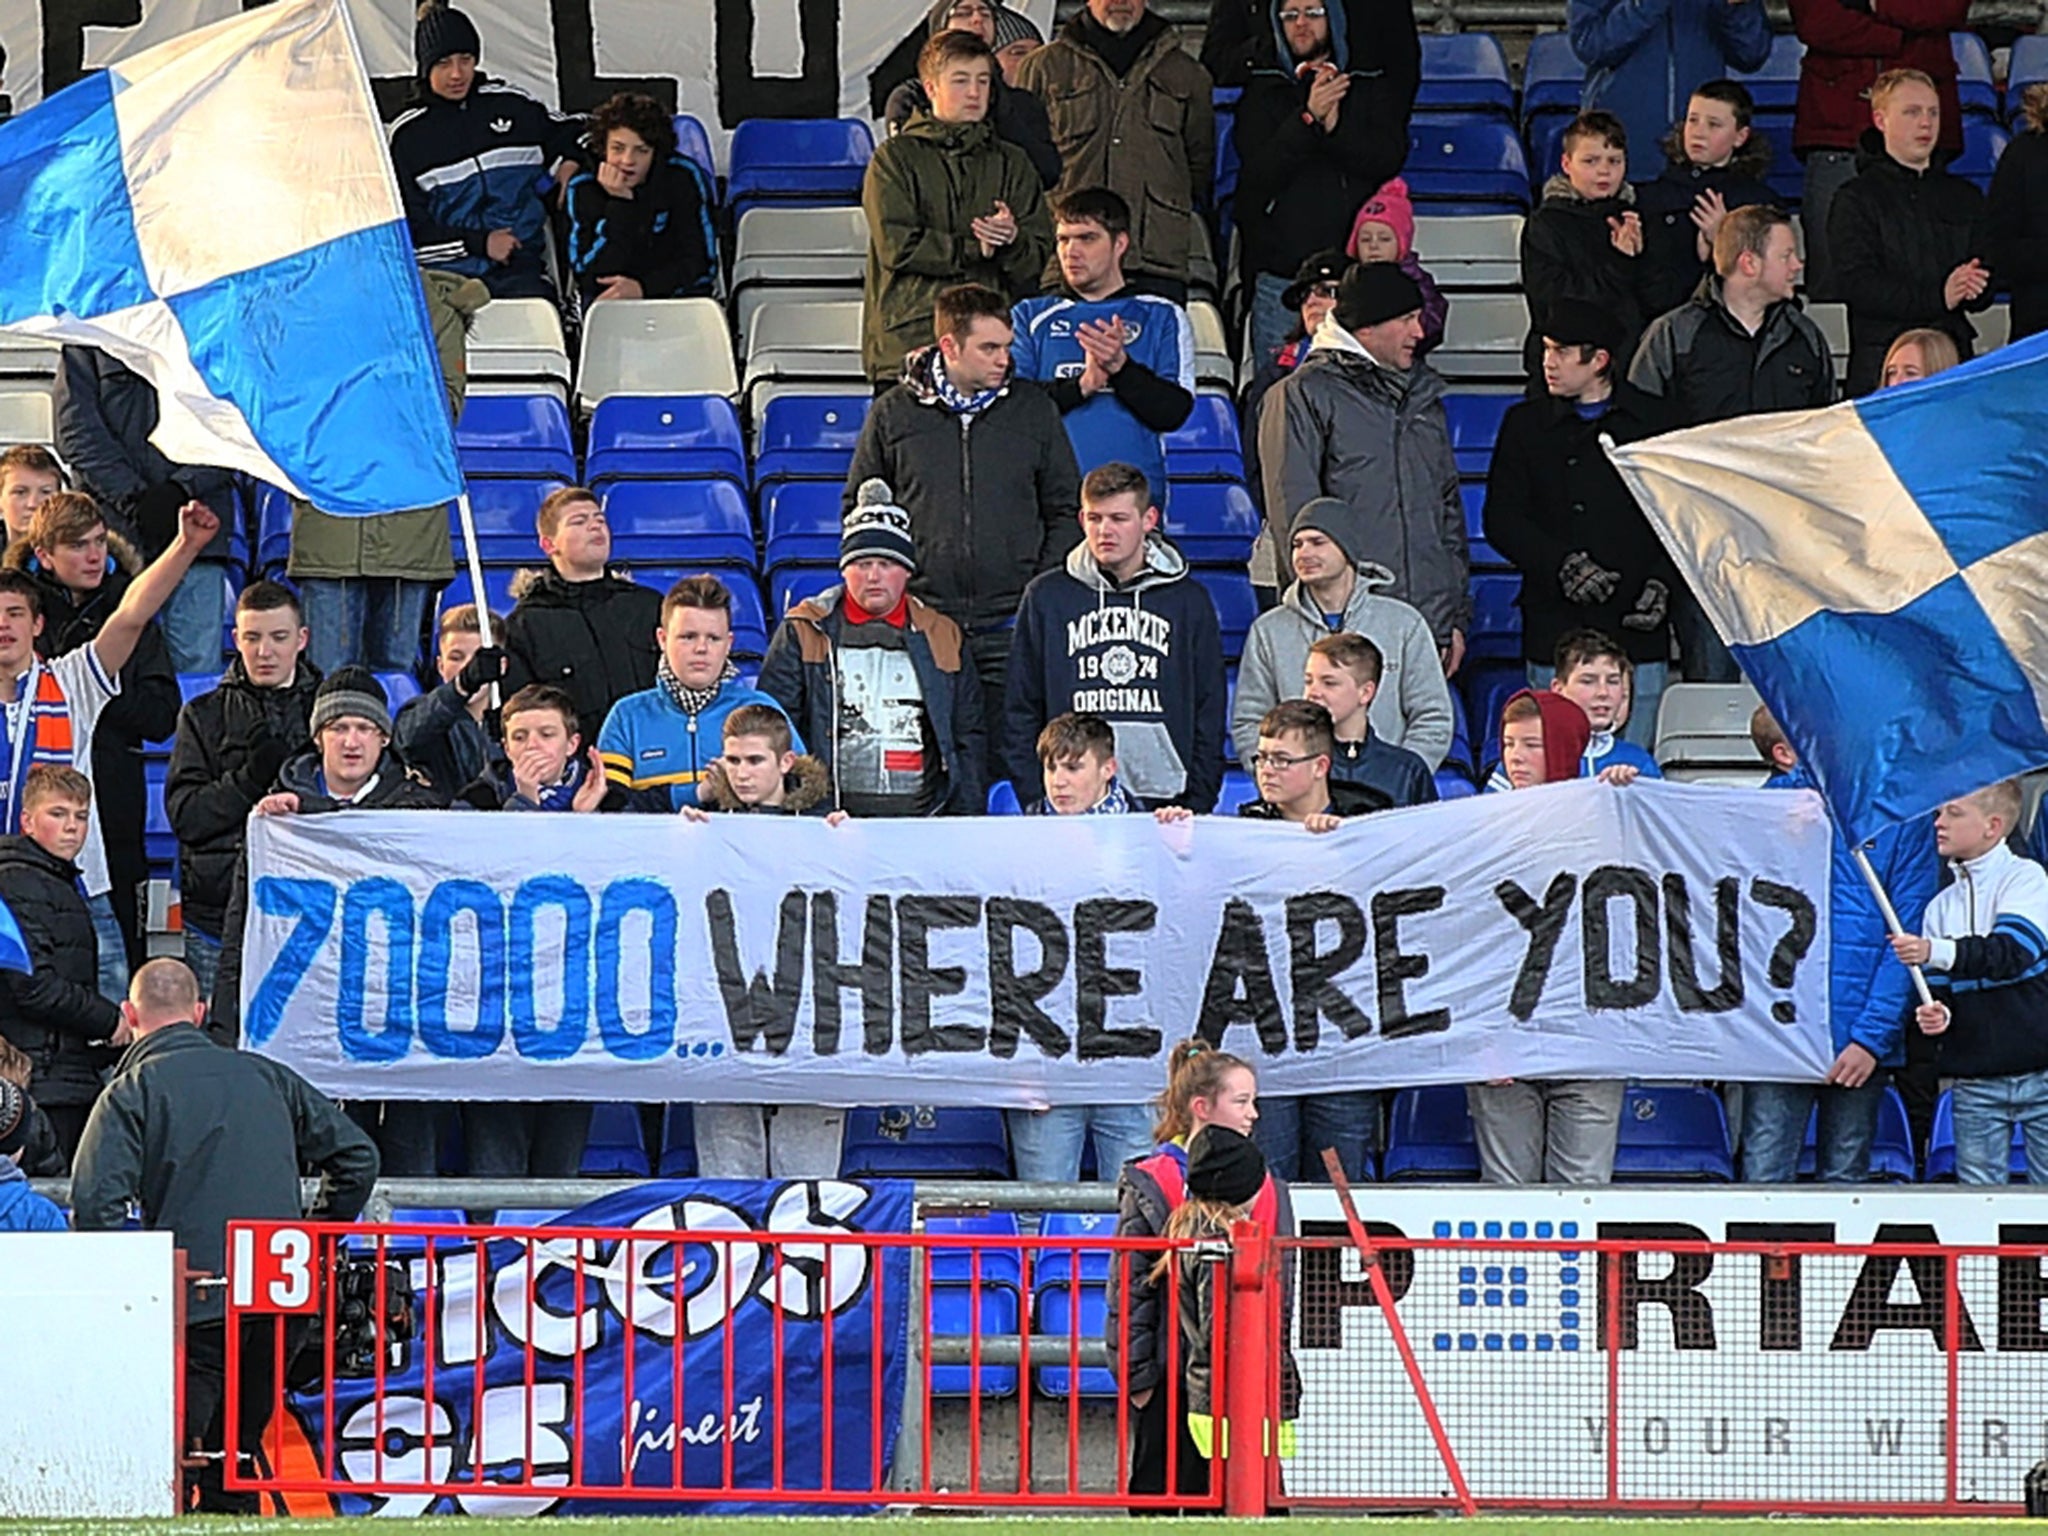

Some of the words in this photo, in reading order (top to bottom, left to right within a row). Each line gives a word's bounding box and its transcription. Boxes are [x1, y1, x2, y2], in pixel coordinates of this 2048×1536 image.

[1067, 606, 1170, 657] MCKENZIE
[1078, 655, 1099, 679] 19
[1138, 655, 1158, 679] 74
[1073, 688, 1164, 713] ORIGINAL
[705, 886, 1163, 1061] WHERE
[1196, 884, 1451, 1056] ARE
[1493, 865, 1817, 1025] YOU?
[234, 1228, 312, 1307] 13
[1584, 1416, 1792, 1456] YOUR
